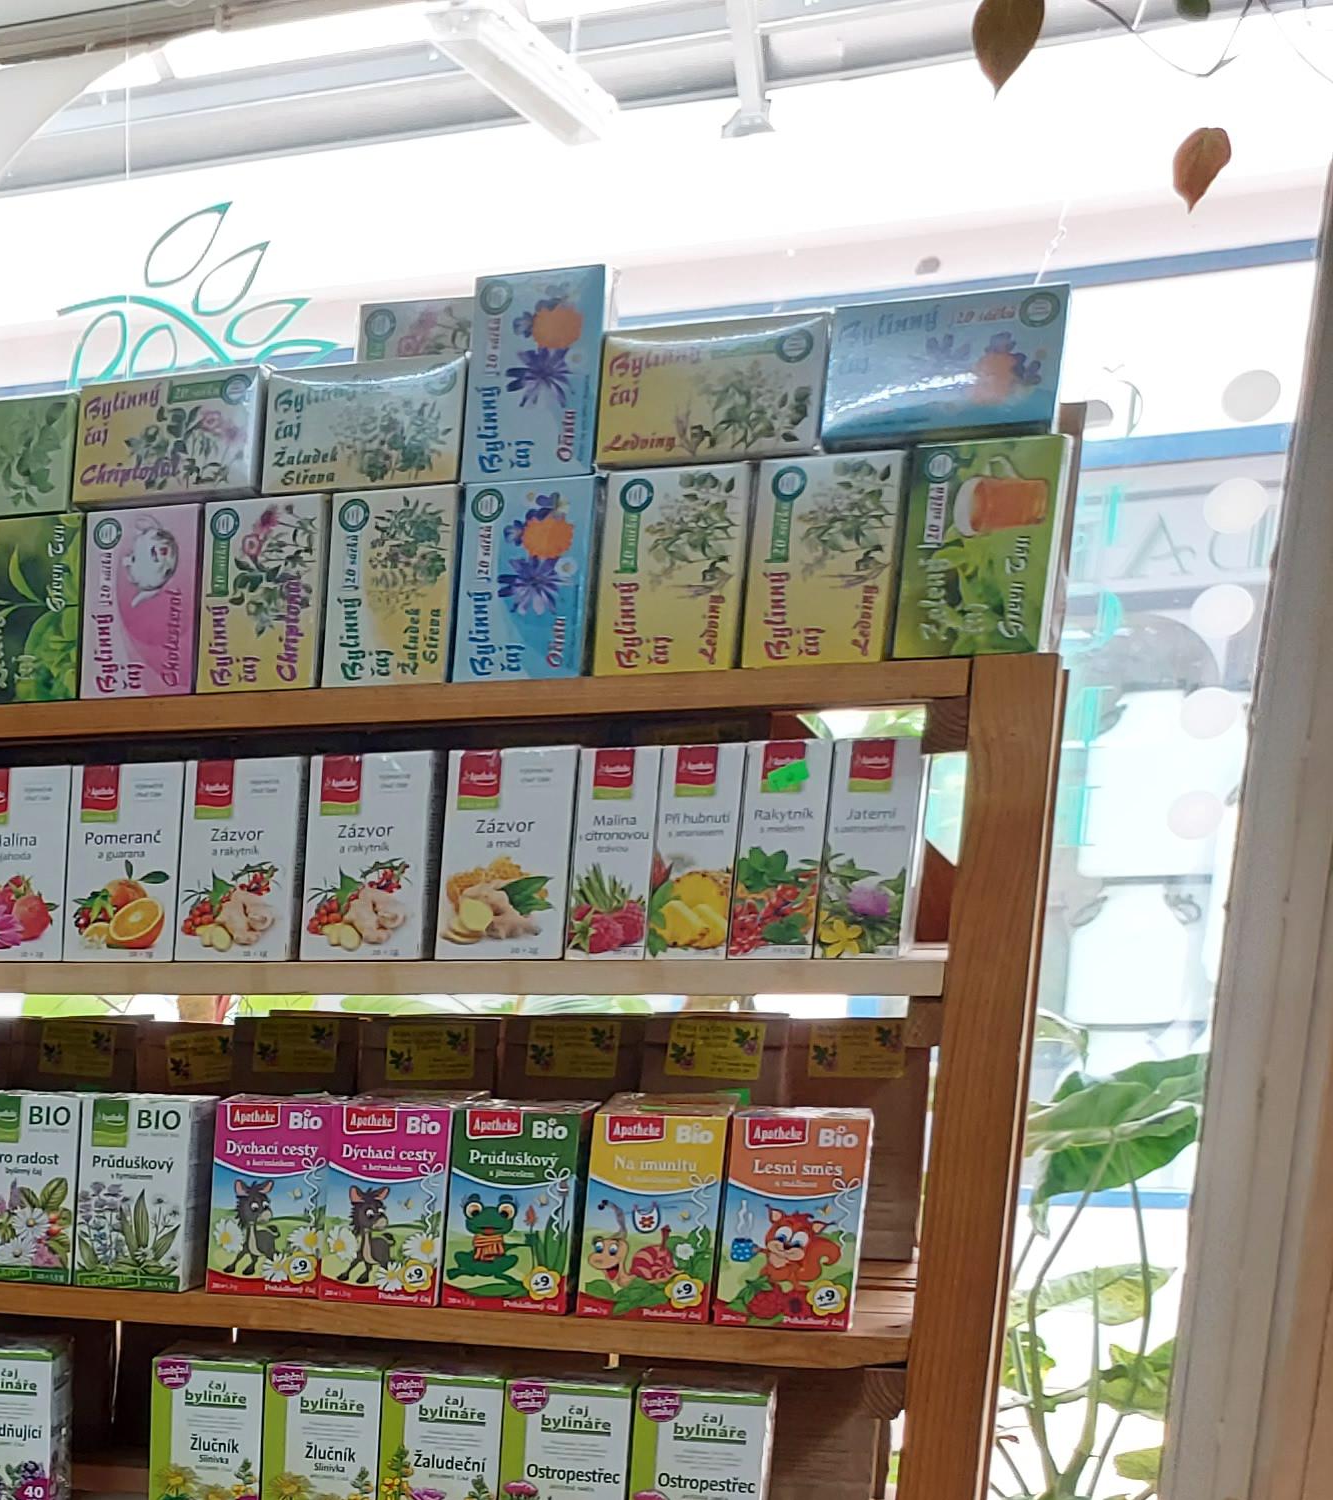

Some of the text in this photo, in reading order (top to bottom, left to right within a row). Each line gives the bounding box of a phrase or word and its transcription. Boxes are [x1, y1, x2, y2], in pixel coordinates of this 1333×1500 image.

[615, 580, 640, 668] Bylinný
[699, 593, 725, 665] Ledviny
[469, 590, 493, 677] Bylinný
[505, 642, 524, 675] čaj
[647, 635, 672, 665] čaj
[593, 814, 636, 826] Malina
[754, 808, 813, 822] Rakytník
[211, 826, 264, 842] Zázvor
[476, 817, 534, 834] Zázvor
[84, 830, 161, 845] Pomeranč
[585, 829, 648, 841] citronovou
[137, 1110, 181, 1130] BIO
[234, 1109, 276, 1126] Apotheke
[289, 1111, 322, 1131] Bio
[474, 1118, 517, 1133] Apotheke
[16, 1152, 58, 1165] radost
[225, 1140, 318, 1160] Dýchací cesty
[93, 1155, 173, 1172] Průduškový
[702, 1413, 725, 1427] čaj
[673, 1424, 747, 1441] bylináře
[190, 1436, 239, 1454] Žlučník
[413, 1451, 486, 1474] Žaludeční
[24, 1486, 43, 1497] 40
[658, 1473, 755, 1494] Ostropestřec
